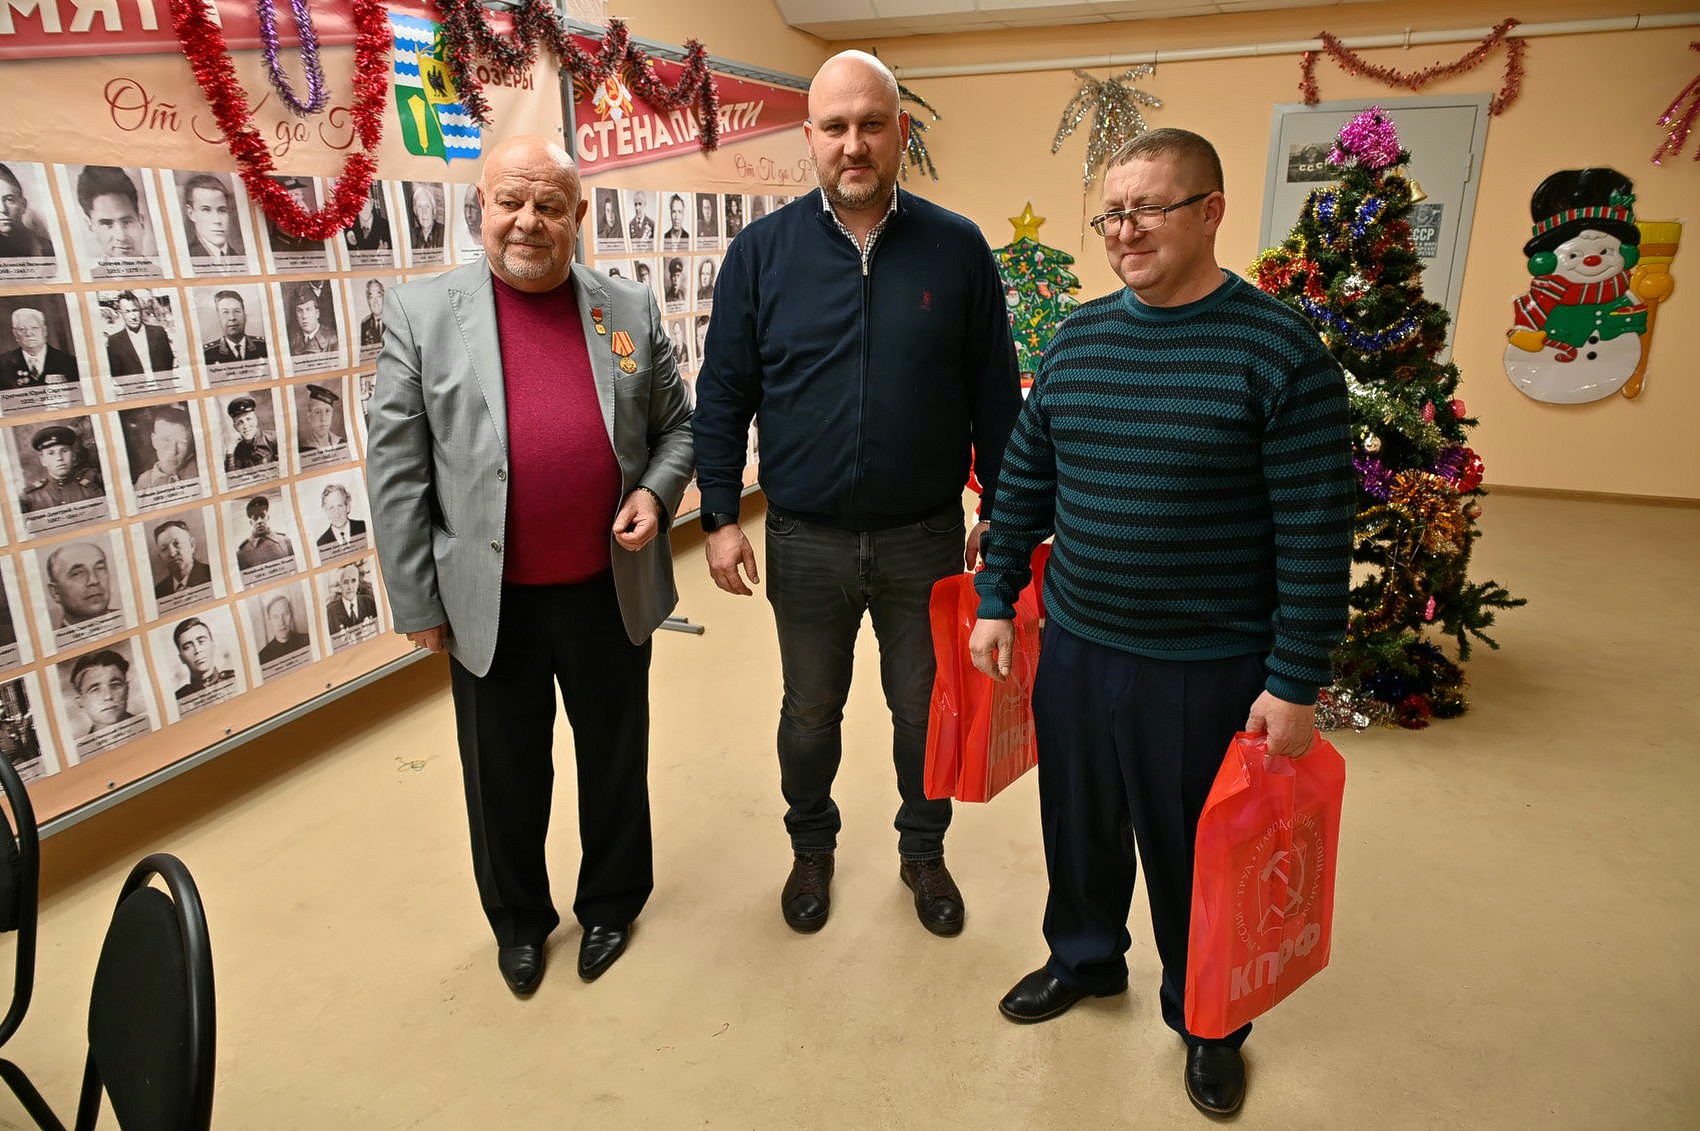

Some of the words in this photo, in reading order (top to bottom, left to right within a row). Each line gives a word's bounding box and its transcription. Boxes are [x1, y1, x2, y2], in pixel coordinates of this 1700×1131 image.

[0, 0, 223, 35] МЯТ
[104, 78, 181, 131] От
[576, 114, 674, 162] СТЕНА
[668, 100, 764, 144] ПАЯТИ
[1412, 227, 1436, 241] ССР
[1230, 922, 1321, 1002] КПРФ
